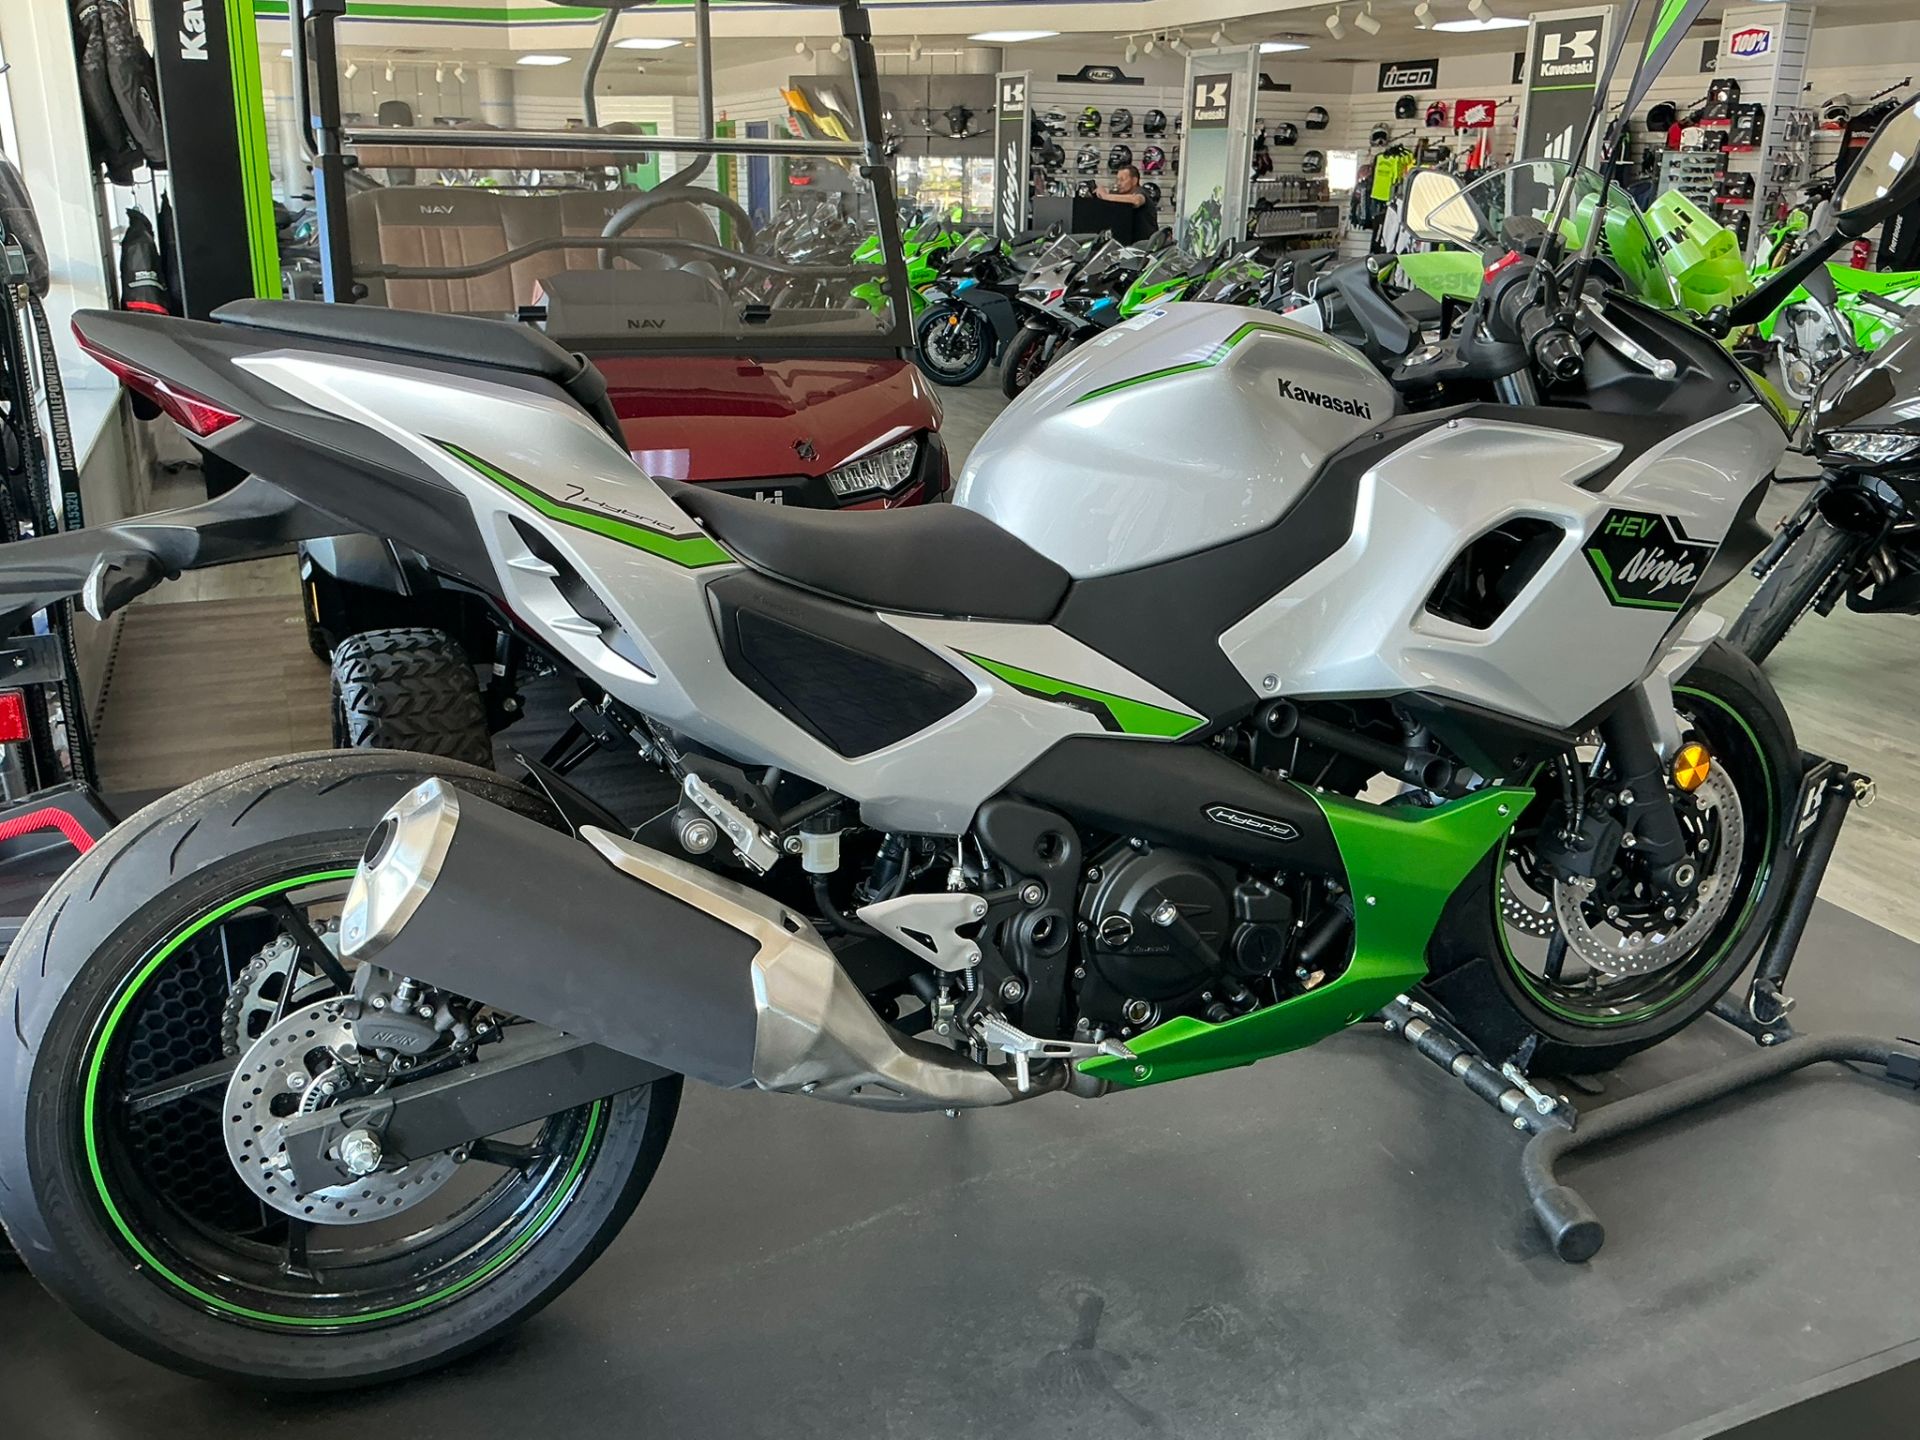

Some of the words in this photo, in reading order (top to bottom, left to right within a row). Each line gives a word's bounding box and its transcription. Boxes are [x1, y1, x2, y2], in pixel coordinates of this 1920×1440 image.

[1732, 32, 1768, 53] 100%
[1540, 60, 1594, 77] Kawasaki
[1194, 107, 1226, 121] Kawasaki
[420, 205, 455, 214] NAV
[627, 318, 667, 329] NAV
[1277, 377, 1372, 420] Kawasaki
[564, 483, 585, 501] 7
[582, 496, 676, 531] Hybrid
[1604, 515, 1658, 538] HEV
[1618, 546, 1697, 595] Ninja
[1215, 810, 1291, 835] Hybrid
